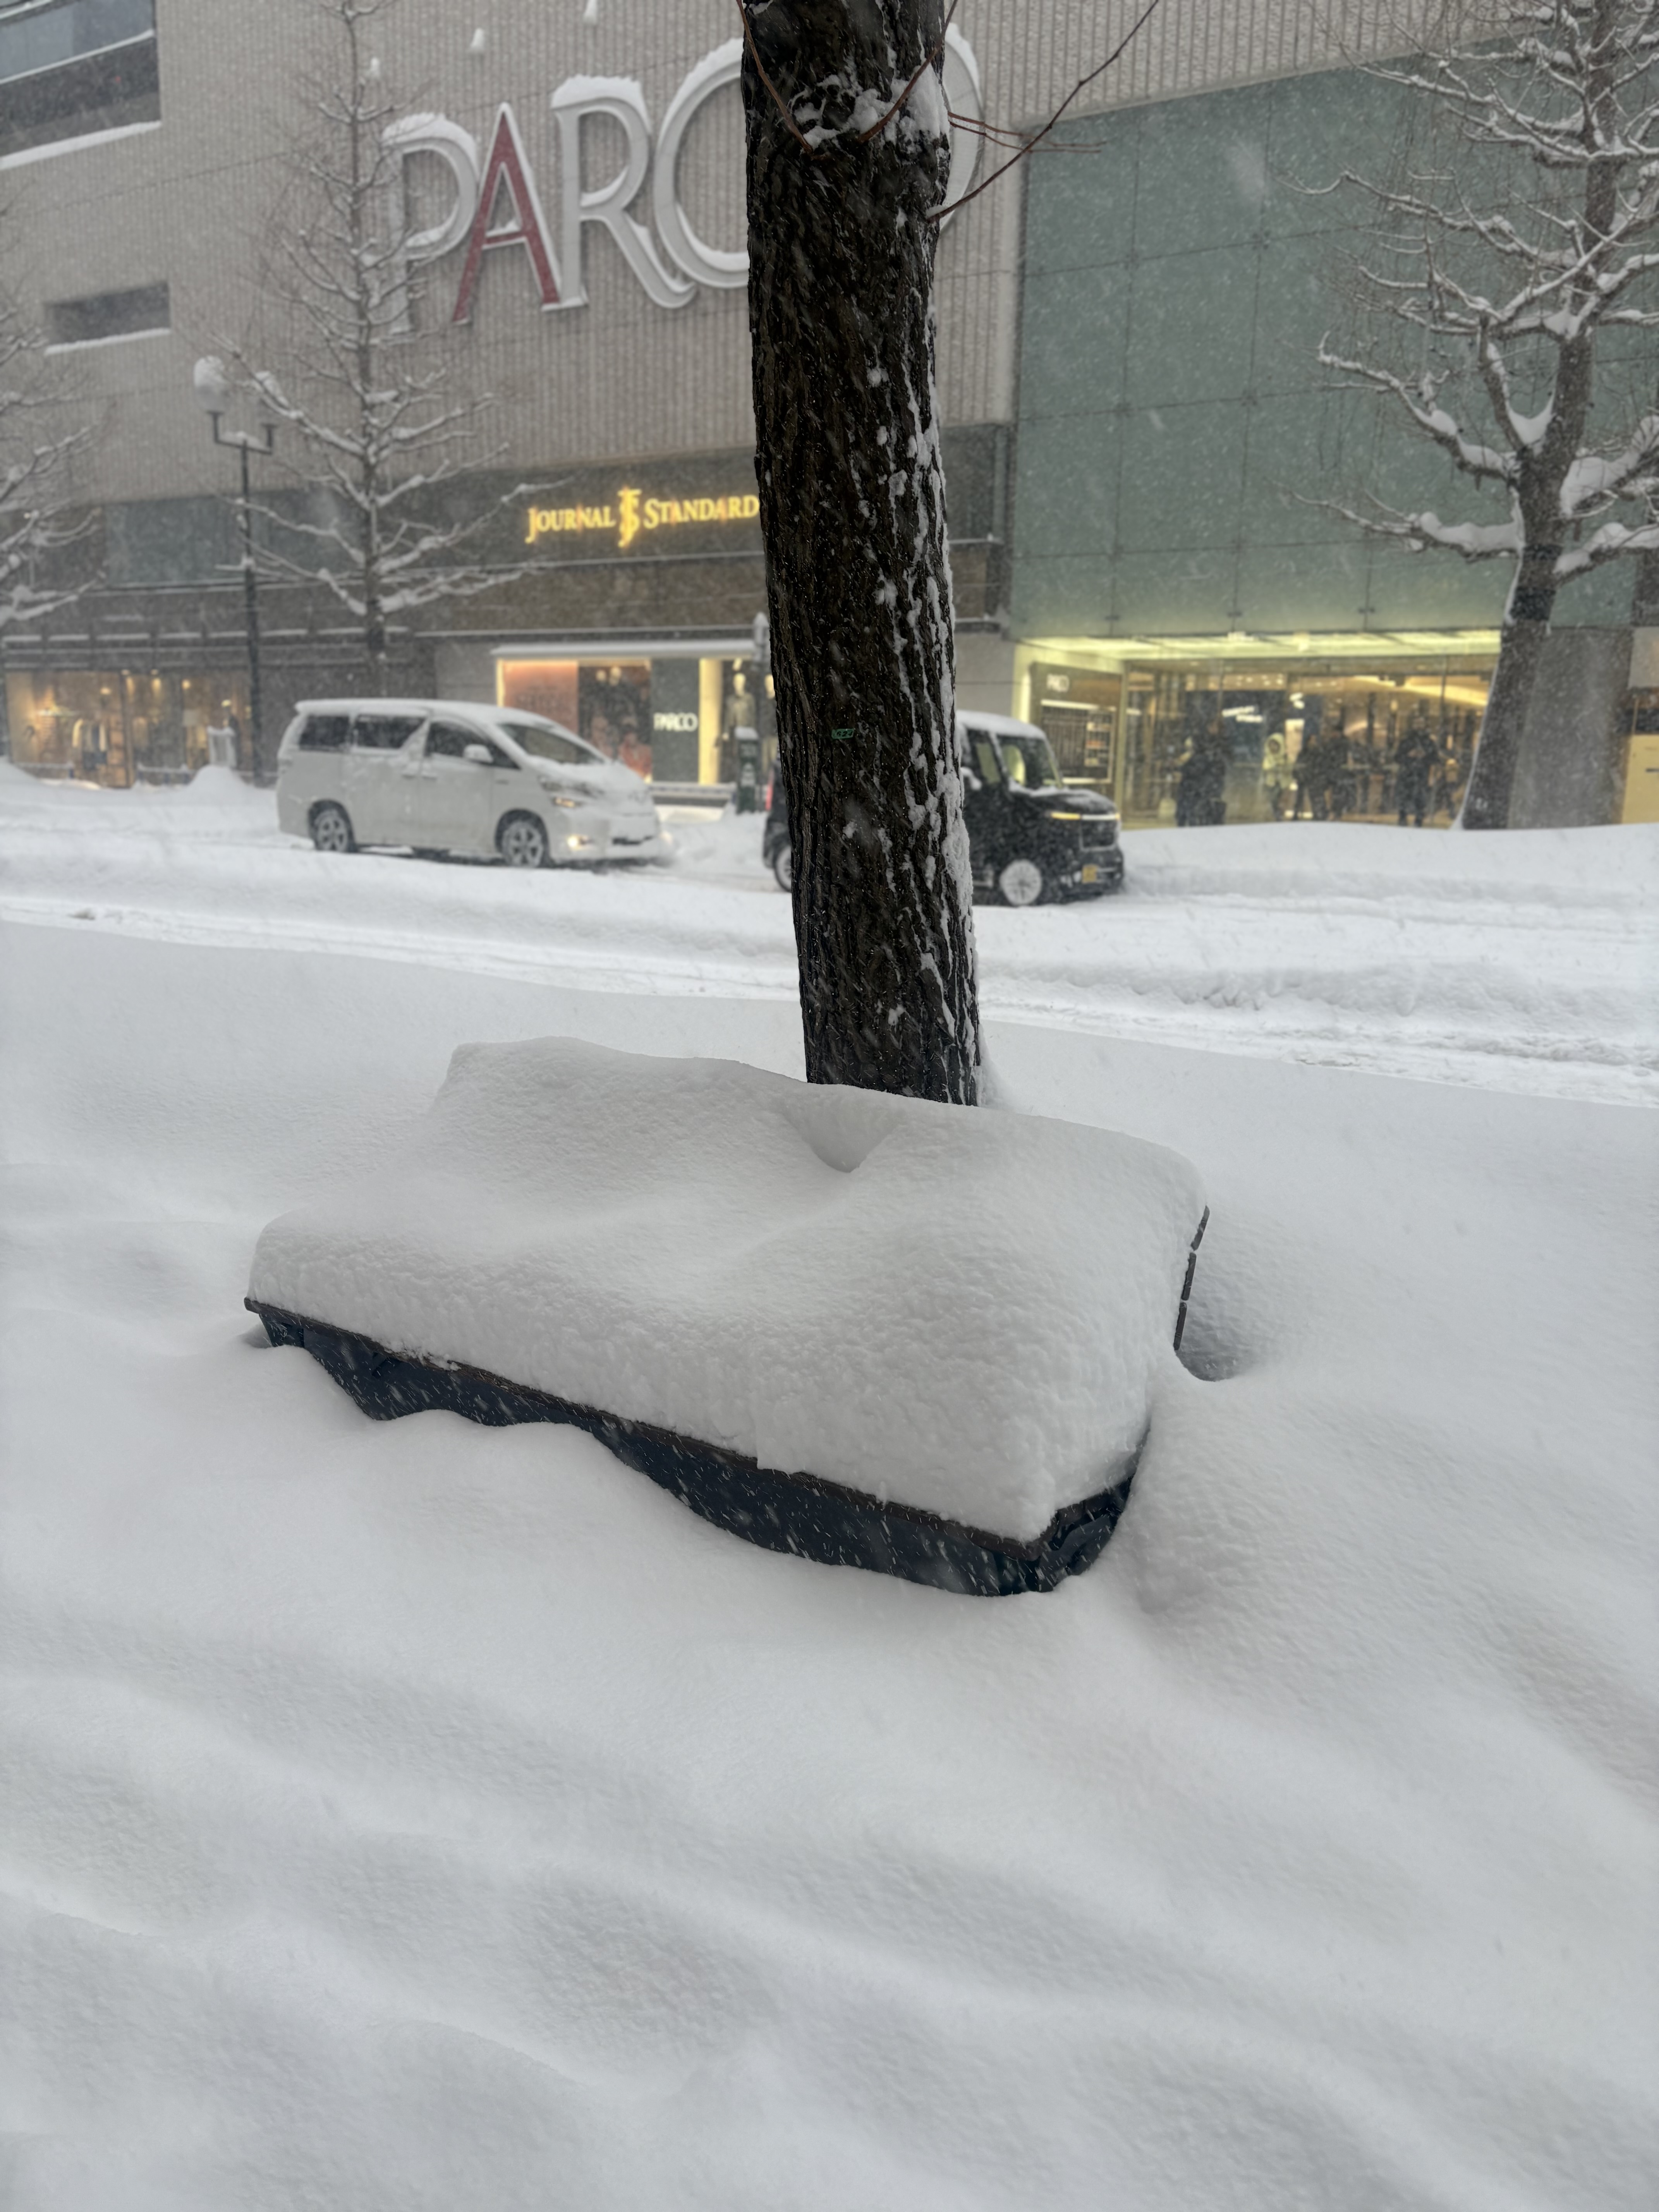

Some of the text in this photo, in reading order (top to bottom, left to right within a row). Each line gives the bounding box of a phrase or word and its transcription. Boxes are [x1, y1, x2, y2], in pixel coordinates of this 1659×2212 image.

[381, 27, 981, 333] PARC
[525, 507, 617, 543] JOURNAL
[643, 495, 759, 529] STANDARD
